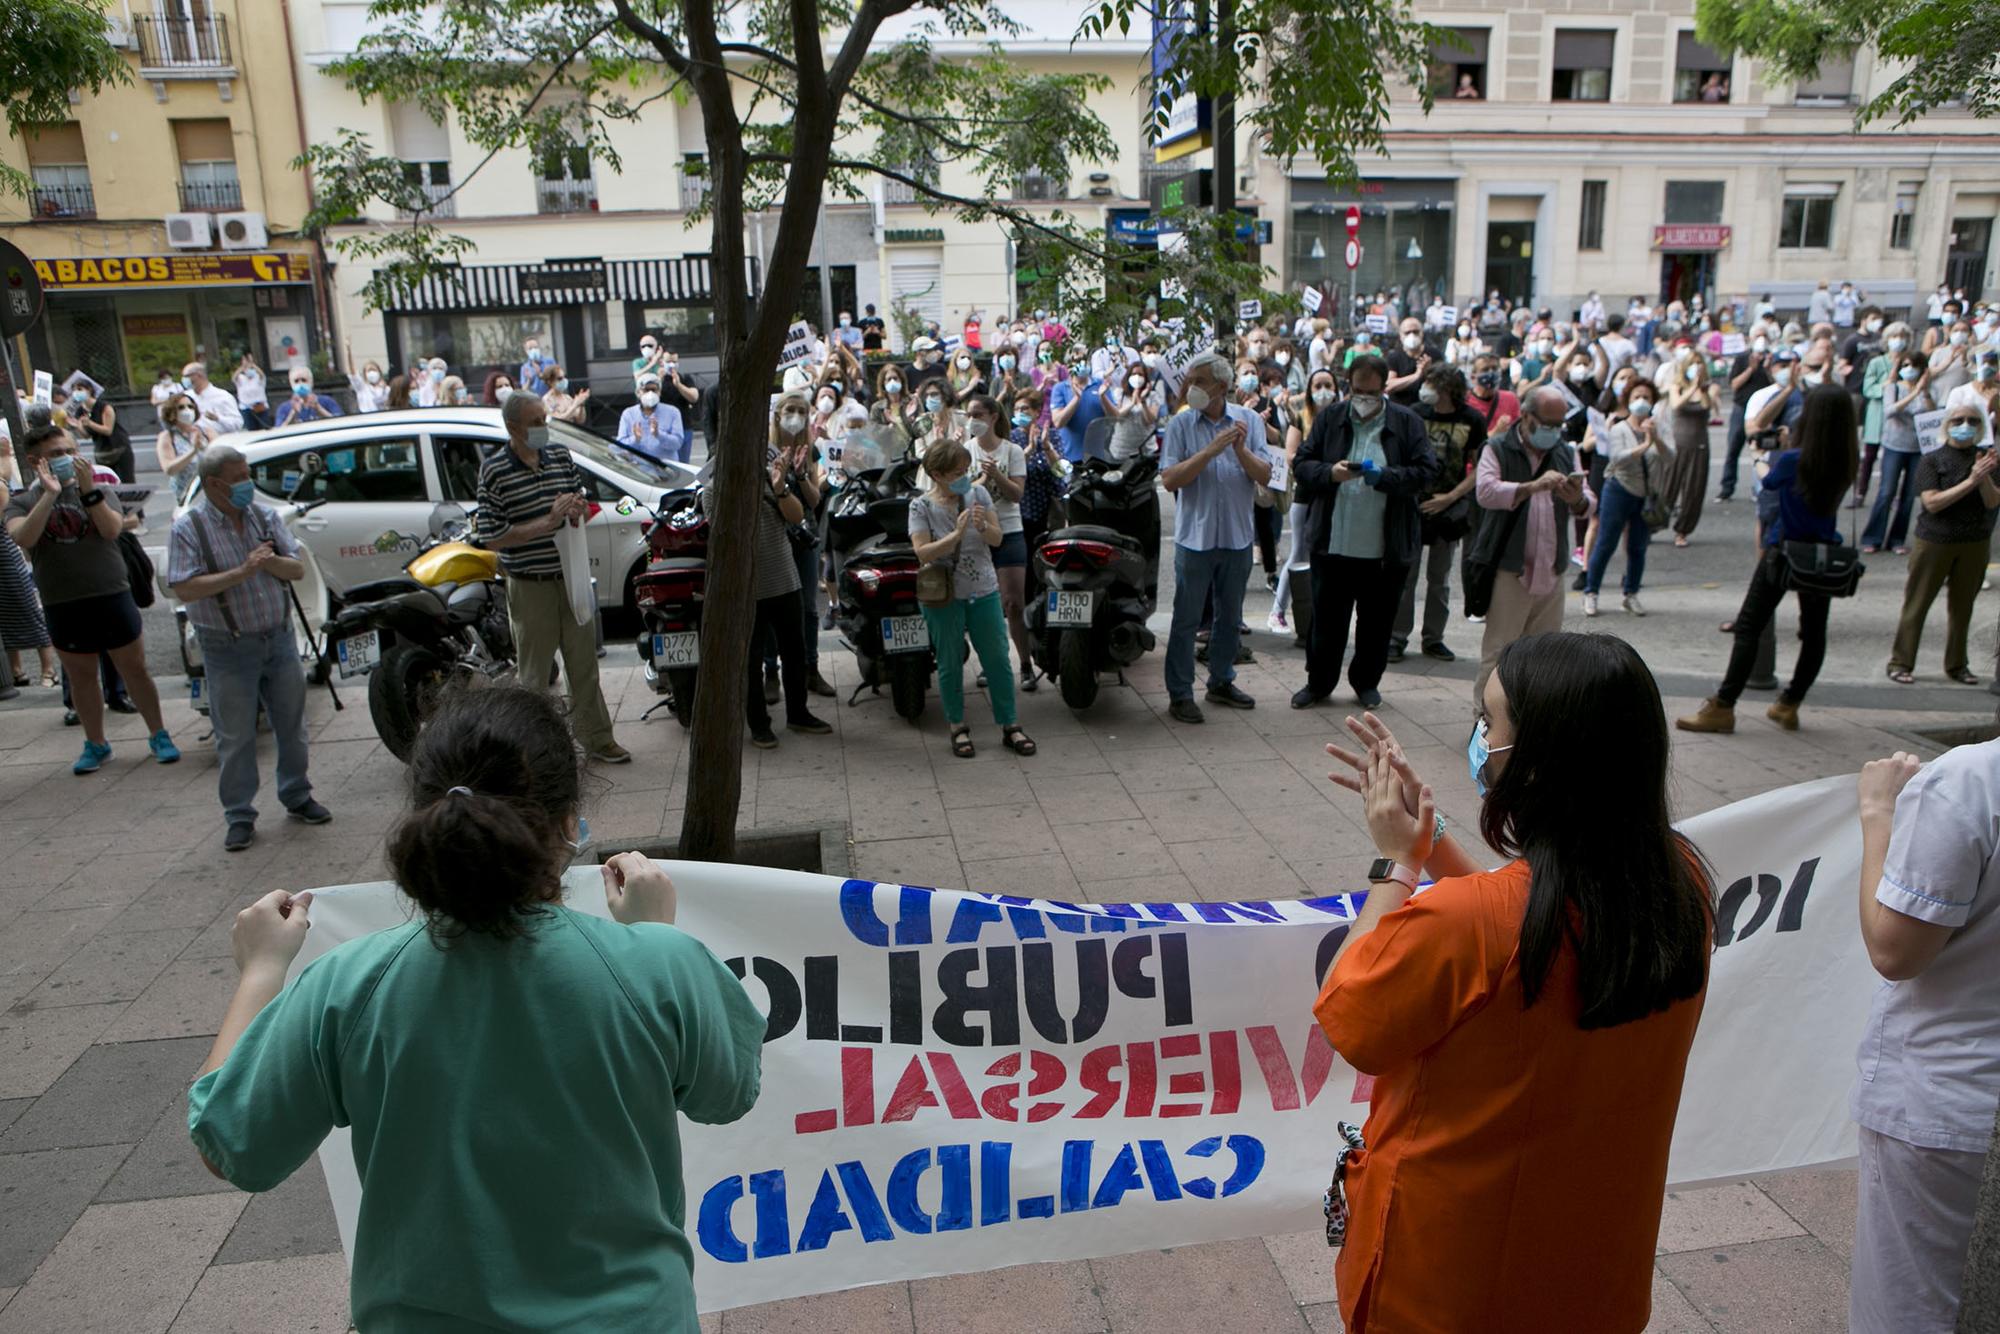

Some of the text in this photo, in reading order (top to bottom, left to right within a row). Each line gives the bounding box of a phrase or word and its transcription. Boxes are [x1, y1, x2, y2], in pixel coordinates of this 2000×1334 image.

[34, 257, 169, 283] ABACOS
[1059, 607, 1082, 620] HRN
[893, 617, 926, 632] 0632
[664, 634, 697, 649] 0777
[894, 632, 919, 646] HVC
[668, 649, 693, 663] KCY
